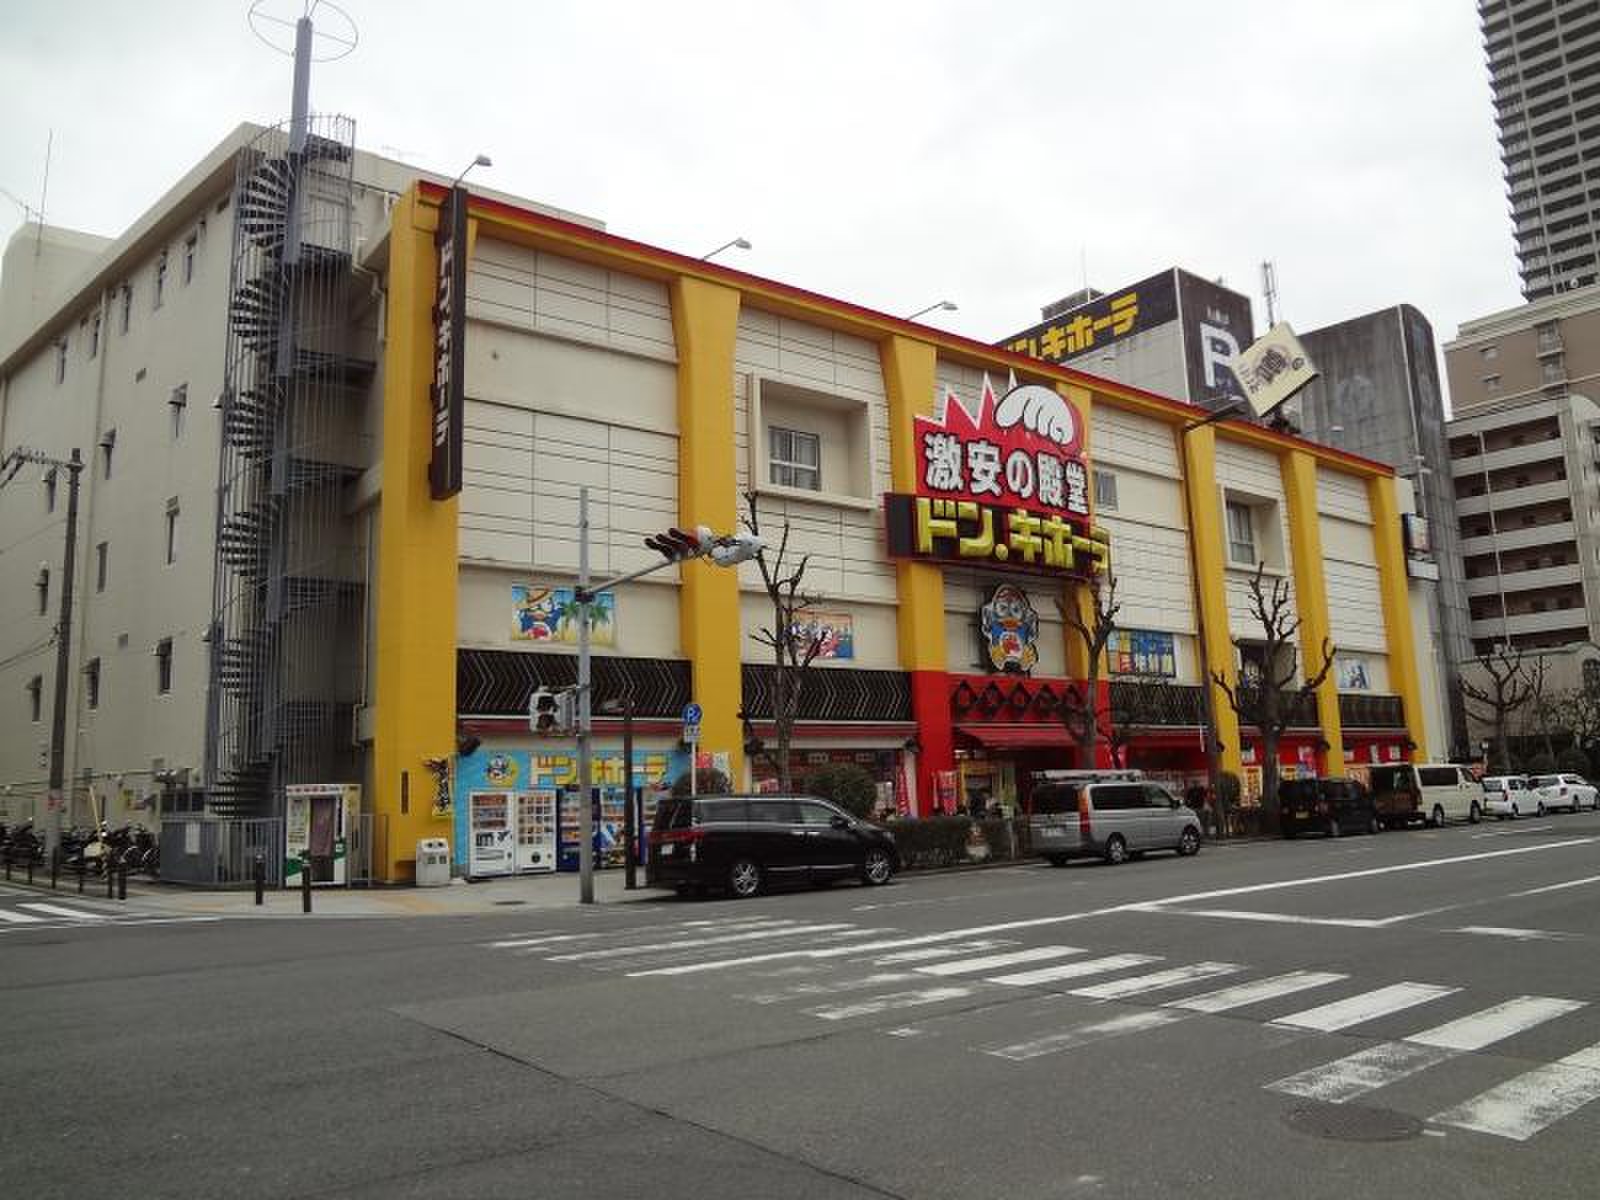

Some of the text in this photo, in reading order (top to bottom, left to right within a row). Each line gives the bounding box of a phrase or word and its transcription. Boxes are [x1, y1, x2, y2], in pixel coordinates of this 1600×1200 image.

[1200, 322, 1240, 388] P
[923, 432, 1090, 515] 激安の殿堂
